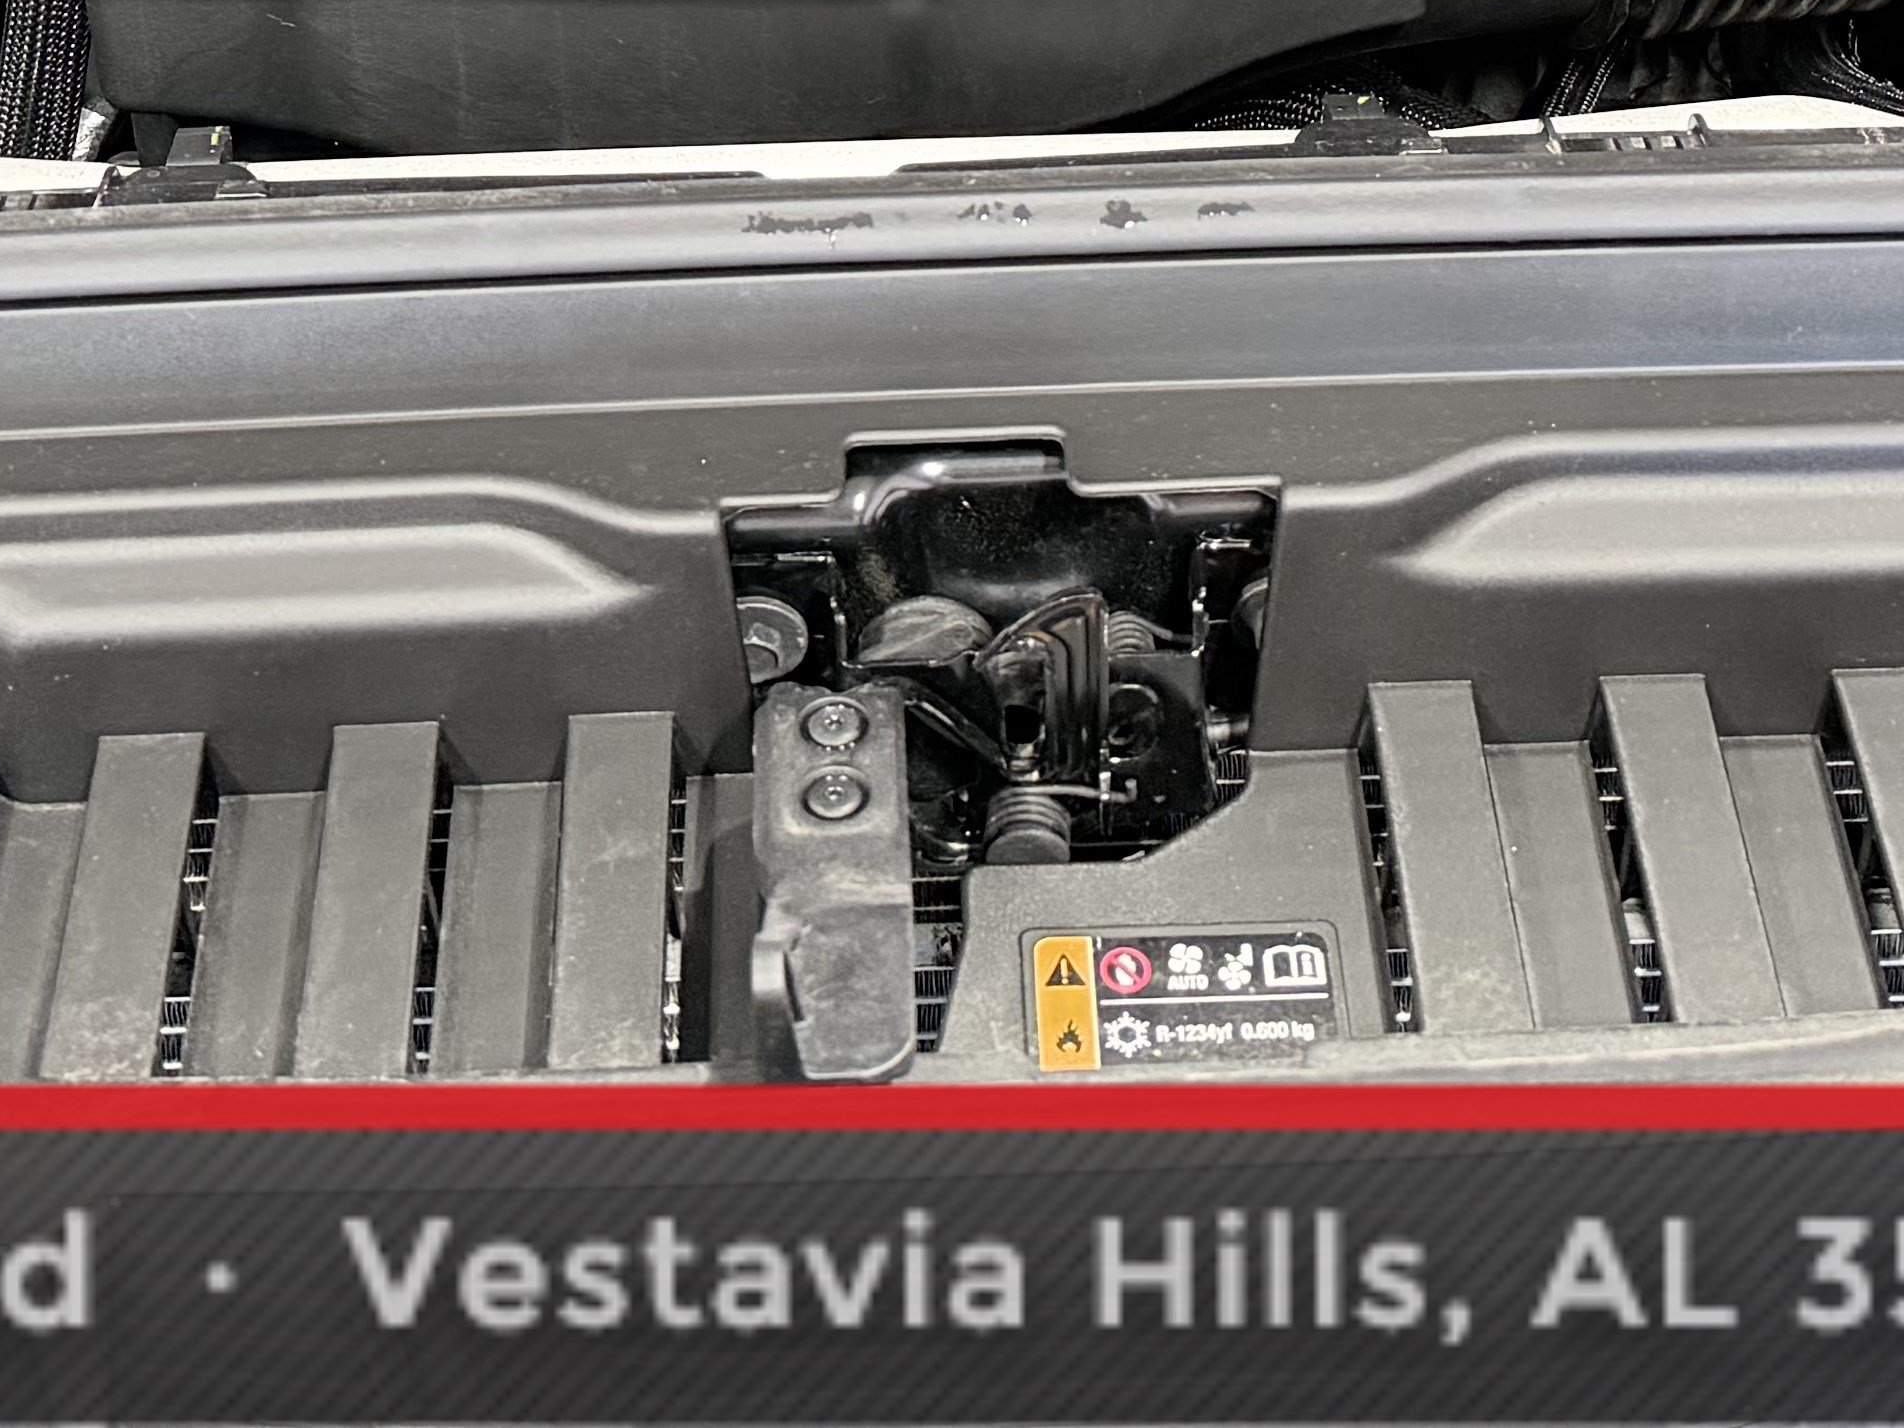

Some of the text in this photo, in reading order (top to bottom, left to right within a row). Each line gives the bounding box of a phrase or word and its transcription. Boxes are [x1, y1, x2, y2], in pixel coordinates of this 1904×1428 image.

[1167, 974, 1210, 991] AUTO
[1155, 1021, 1234, 1045] R-1234yf
[1291, 1020, 1316, 1042] kg
